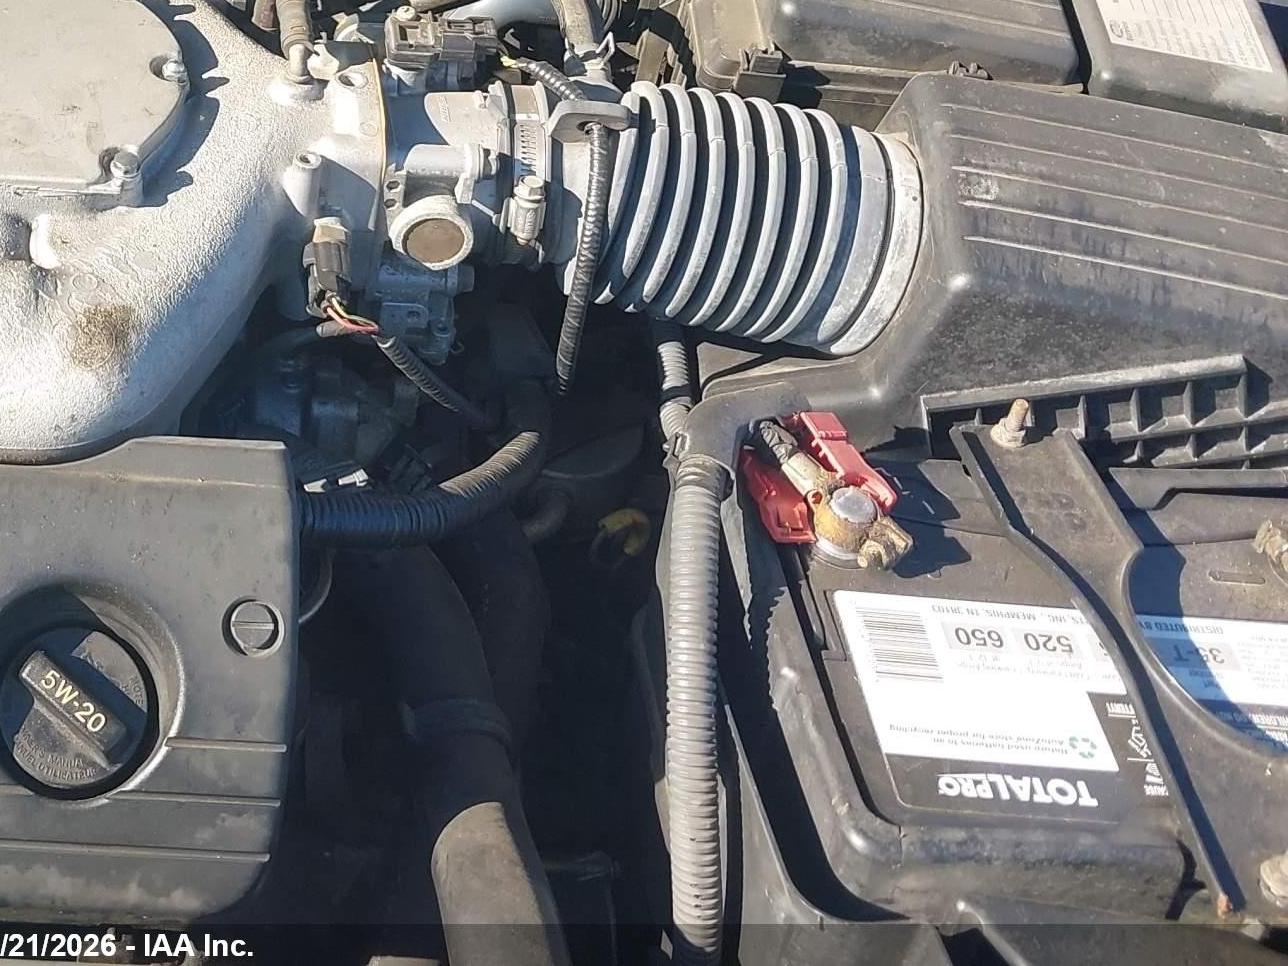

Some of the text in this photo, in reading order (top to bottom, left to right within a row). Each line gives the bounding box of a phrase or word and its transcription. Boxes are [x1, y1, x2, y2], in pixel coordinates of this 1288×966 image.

[954, 626, 1005, 649] 650
[1023, 632, 1074, 653] 520
[40, 670, 107, 732] 5W-20
[936, 772, 1099, 808] TOTALPRO
